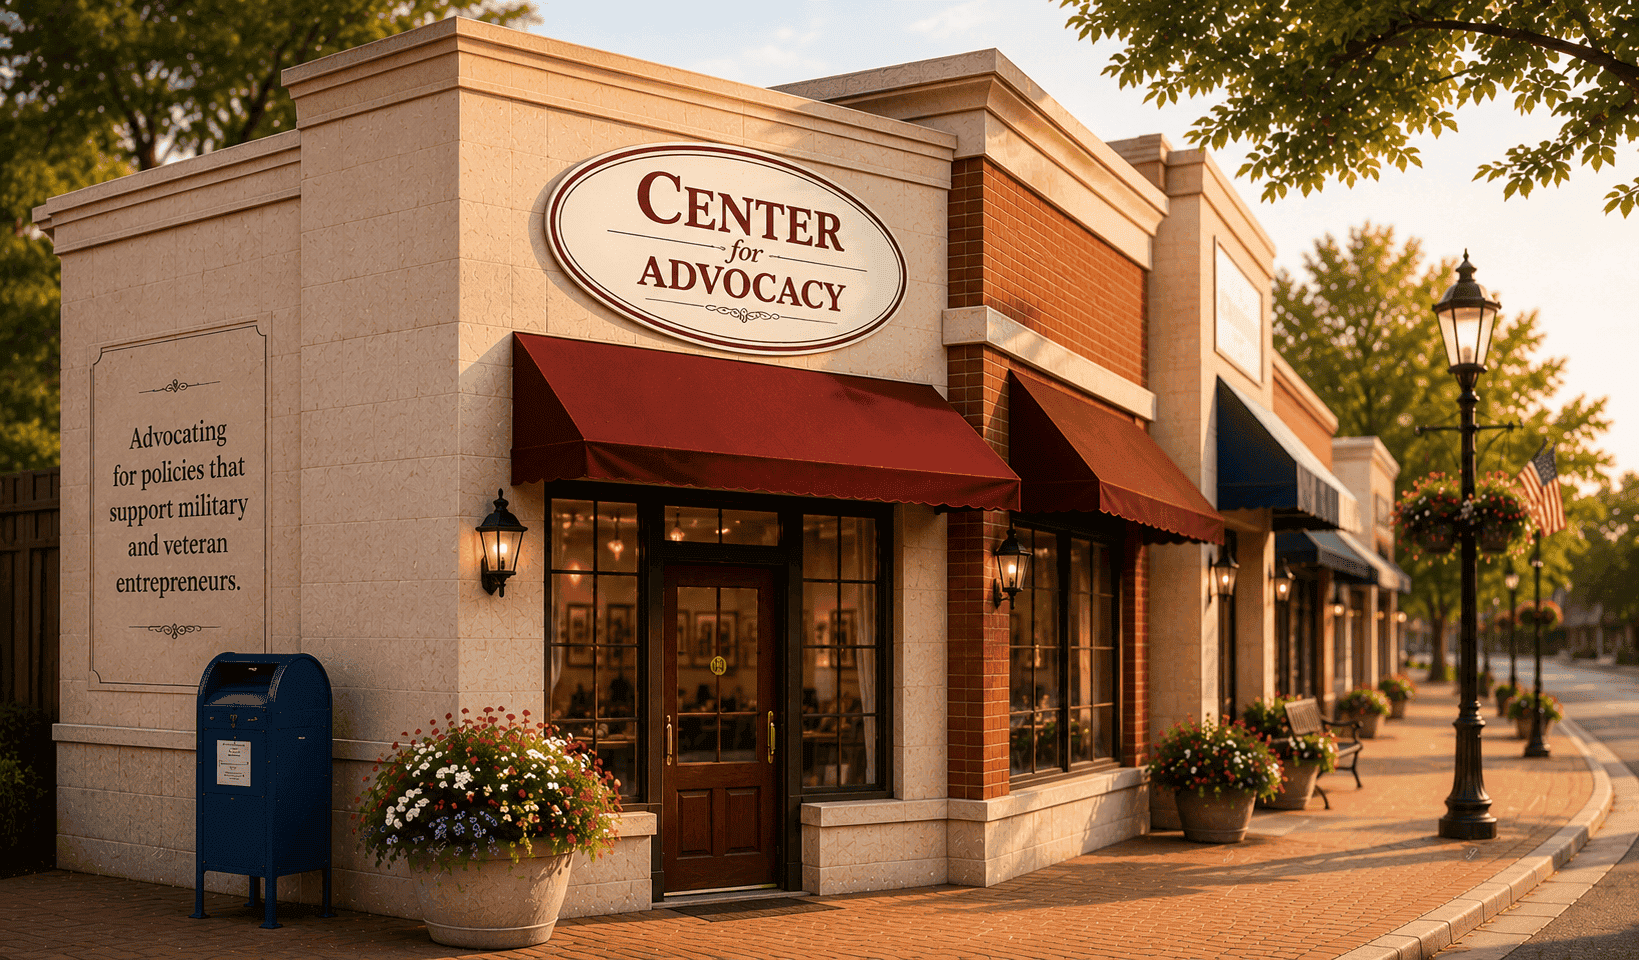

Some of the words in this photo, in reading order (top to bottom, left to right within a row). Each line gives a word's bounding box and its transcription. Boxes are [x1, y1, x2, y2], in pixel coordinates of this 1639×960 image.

[637, 170, 845, 252] CENTER
[725, 239, 763, 264] for
[637, 256, 846, 312] ADVOCACY
[129, 420, 227, 450] Advocating
[113, 465, 137, 487] for
[141, 459, 204, 490] policies
[209, 455, 245, 479] that
[109, 499, 173, 527] support
[178, 494, 249, 520] military
[128, 533, 159, 557] and
[163, 536, 228, 555] veteran
[116, 573, 241, 598] entrepreneurs.
